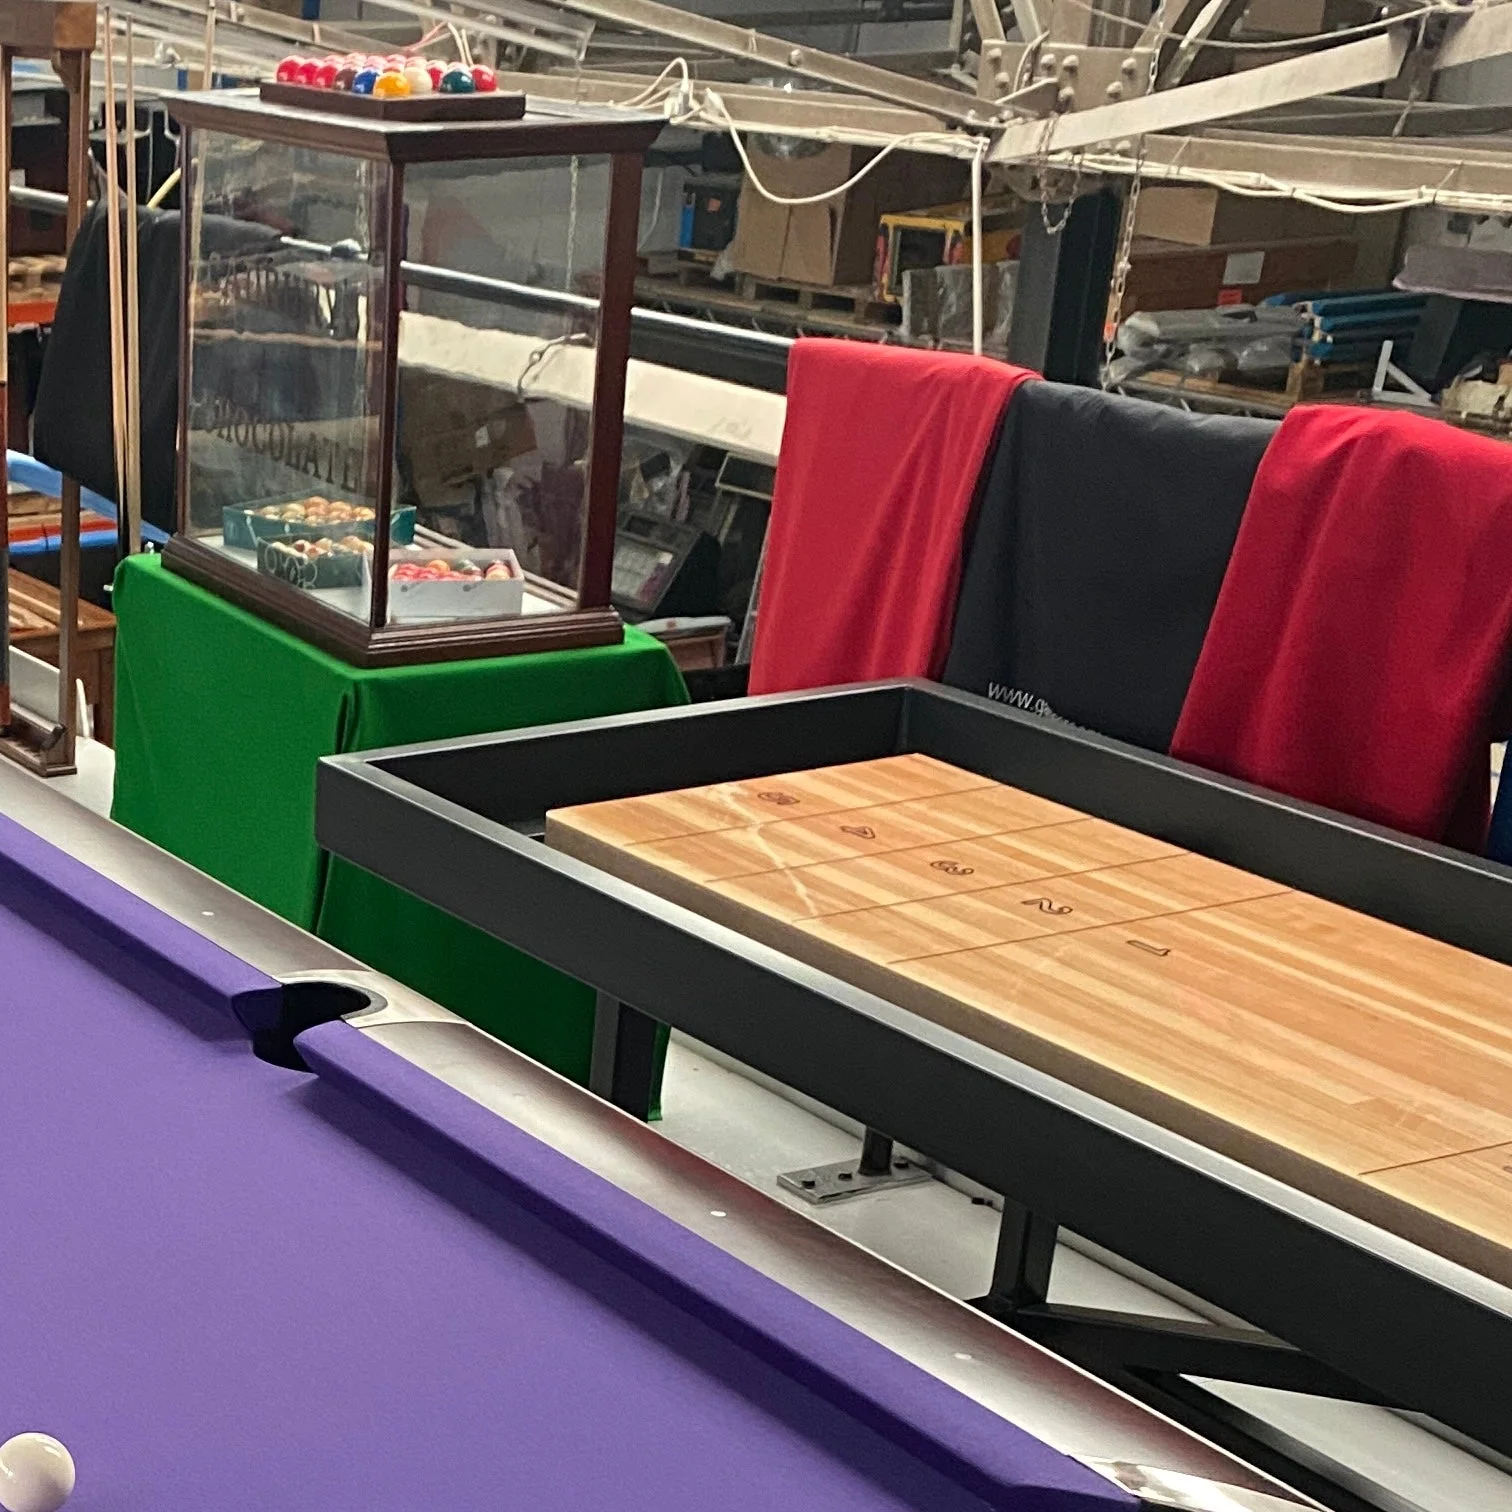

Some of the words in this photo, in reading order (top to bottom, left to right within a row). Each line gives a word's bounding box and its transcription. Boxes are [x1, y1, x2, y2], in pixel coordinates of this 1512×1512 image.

[930, 860, 974, 876] 3
[1021, 897, 1073, 915] 2
[1126, 939, 1171, 957] 1
